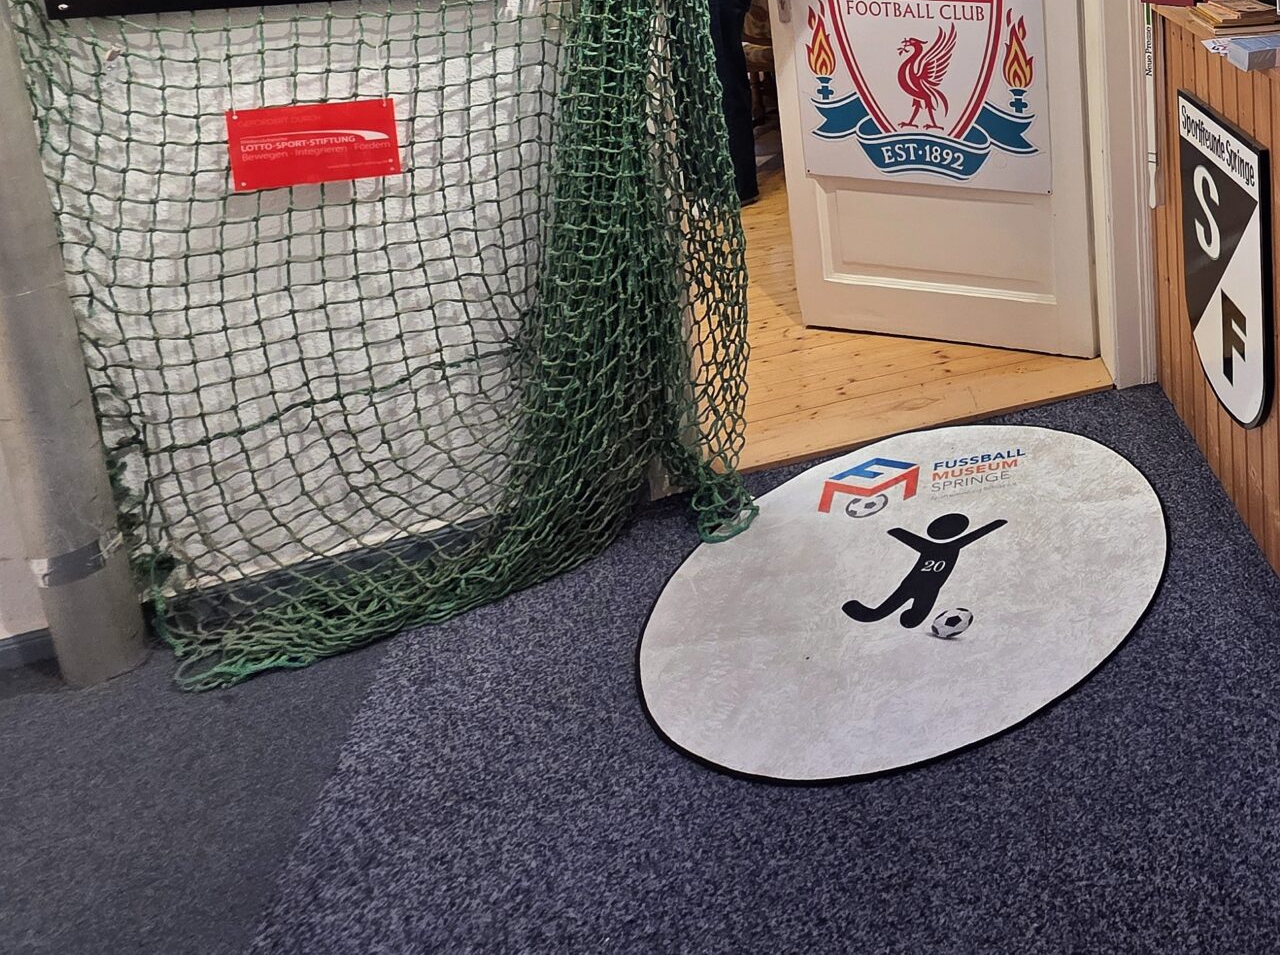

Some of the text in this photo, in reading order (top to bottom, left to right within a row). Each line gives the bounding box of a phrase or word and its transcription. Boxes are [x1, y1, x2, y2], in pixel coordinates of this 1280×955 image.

[846, 0, 985, 21] FOOTBALL CLUB
[1181, 104, 1256, 187] Sportfreunde Springe
[1193, 164, 1221, 261] S
[1220, 288, 1247, 387] F
[931, 459, 1018, 481] MUSEUM
[933, 448, 1026, 471] FUSSBALL
[931, 470, 1010, 493] SPRINGE
[920, 560, 946, 573] 20
